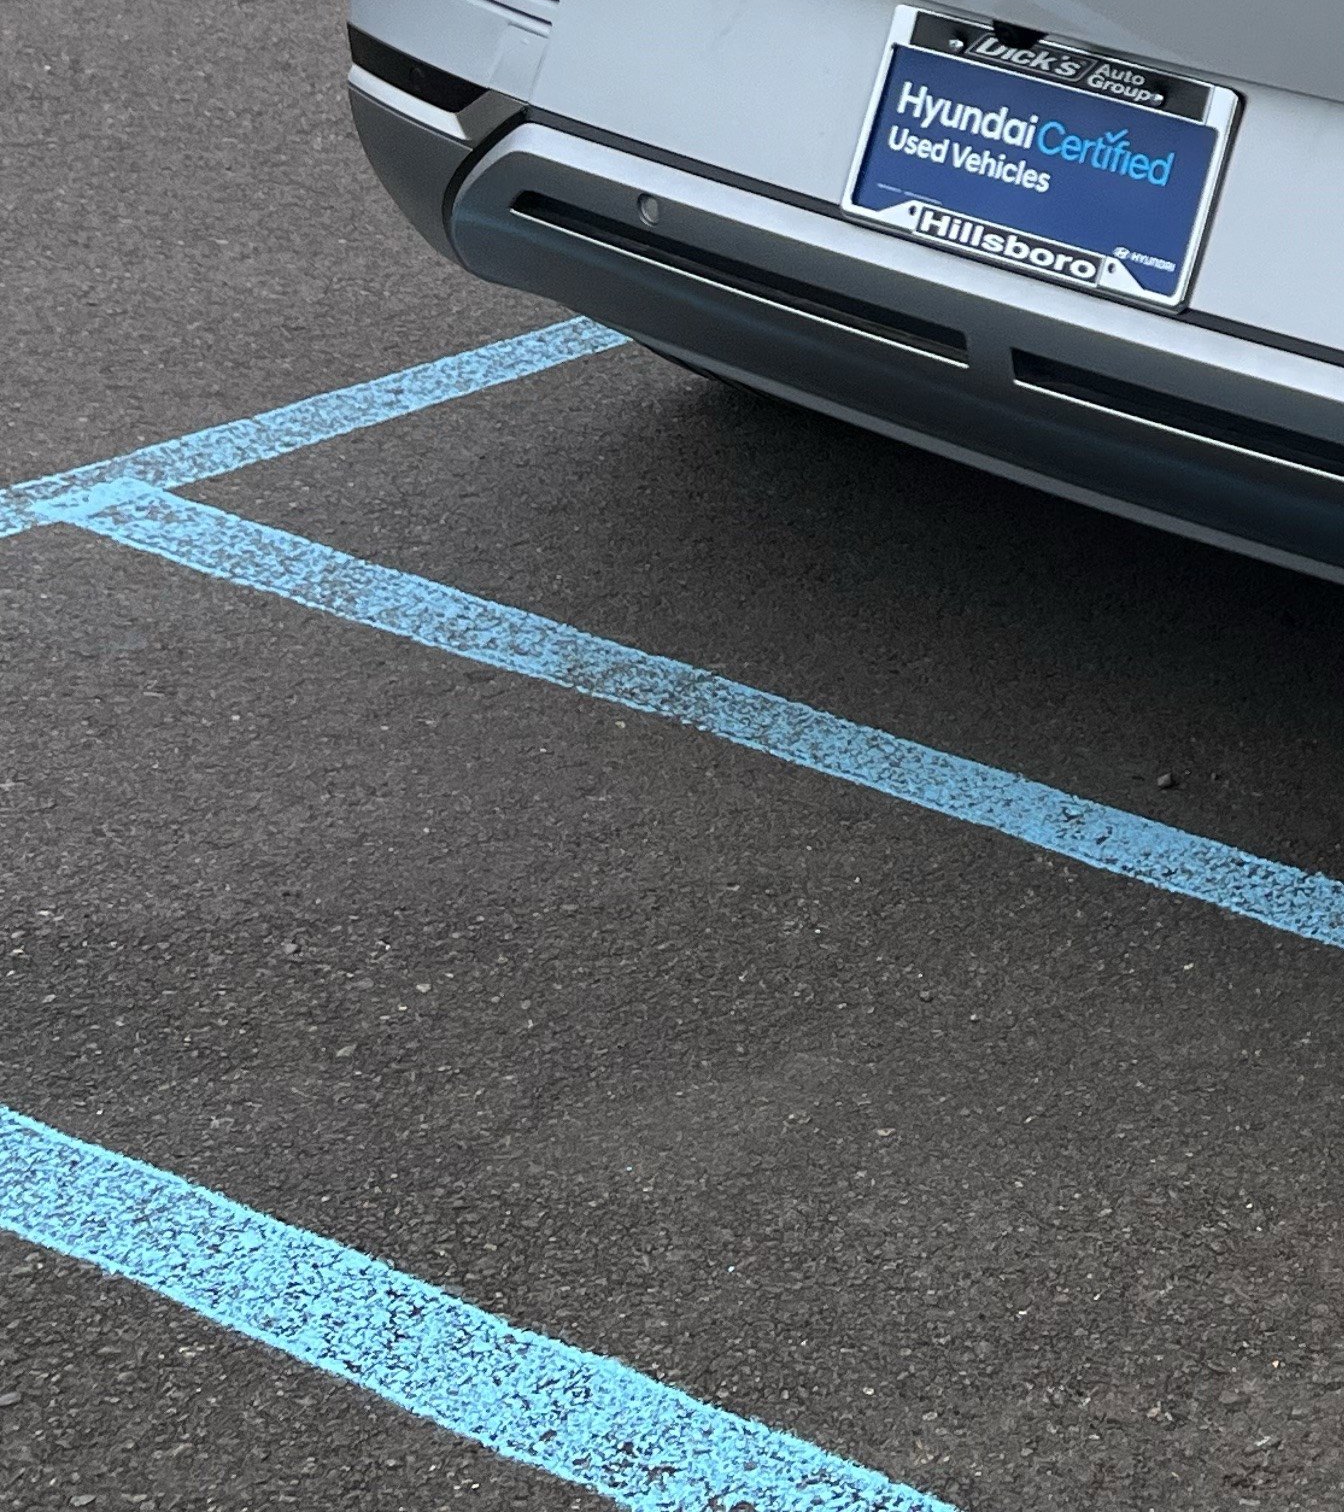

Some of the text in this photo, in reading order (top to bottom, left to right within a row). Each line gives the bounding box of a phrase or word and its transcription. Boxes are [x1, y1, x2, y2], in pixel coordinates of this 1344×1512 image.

[1087, 74, 1151, 102] Group
[1093, 63, 1145, 86] Auto
[889, 125, 1051, 193] Used Vehicles
[898, 81, 1175, 187] Hyundai Certified
[919, 209, 1097, 280] Hillsboro
